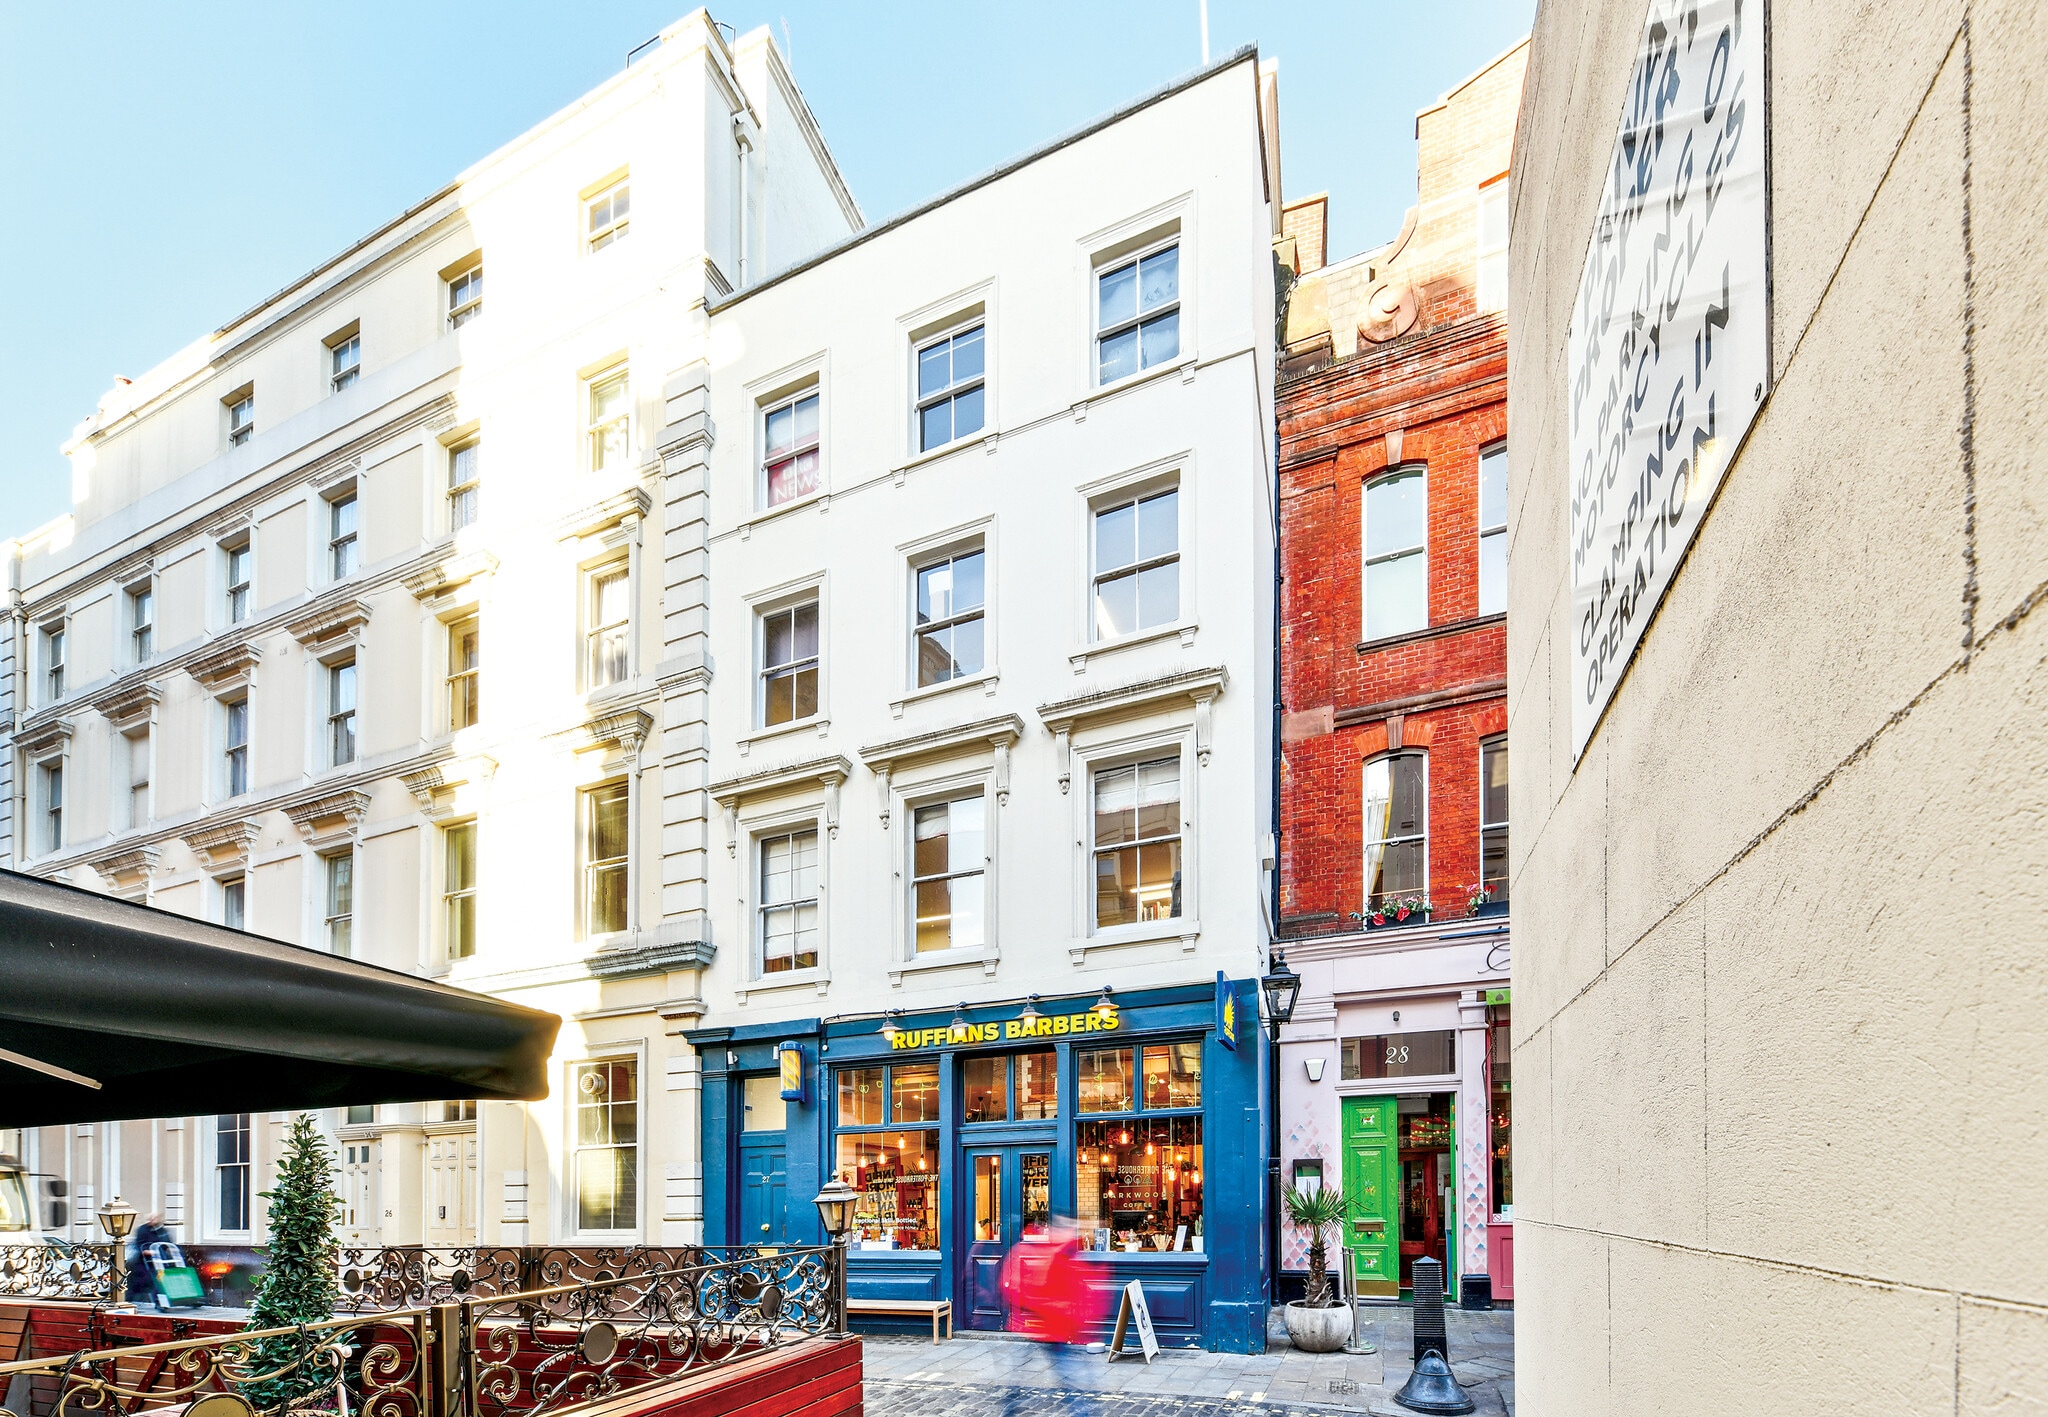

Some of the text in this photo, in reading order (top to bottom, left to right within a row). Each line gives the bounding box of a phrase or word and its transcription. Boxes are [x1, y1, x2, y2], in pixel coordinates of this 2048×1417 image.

[1584, 0, 1676, 336] PRIVA
[1572, 447, 1594, 534] NO
[1597, 127, 1694, 446] PARKING
[1575, 70, 1746, 587] MOTORCYCLES
[1580, 260, 1730, 658] CLAMPING IN
[1586, 389, 1716, 706] OPERATION
[762, 1175, 771, 1183] 27
[892, 1011, 1120, 1050] RUFFIANS BARBERS
[1385, 1045, 1410, 1064] 28
[1102, 1190, 1175, 1199] DARKWOODS
